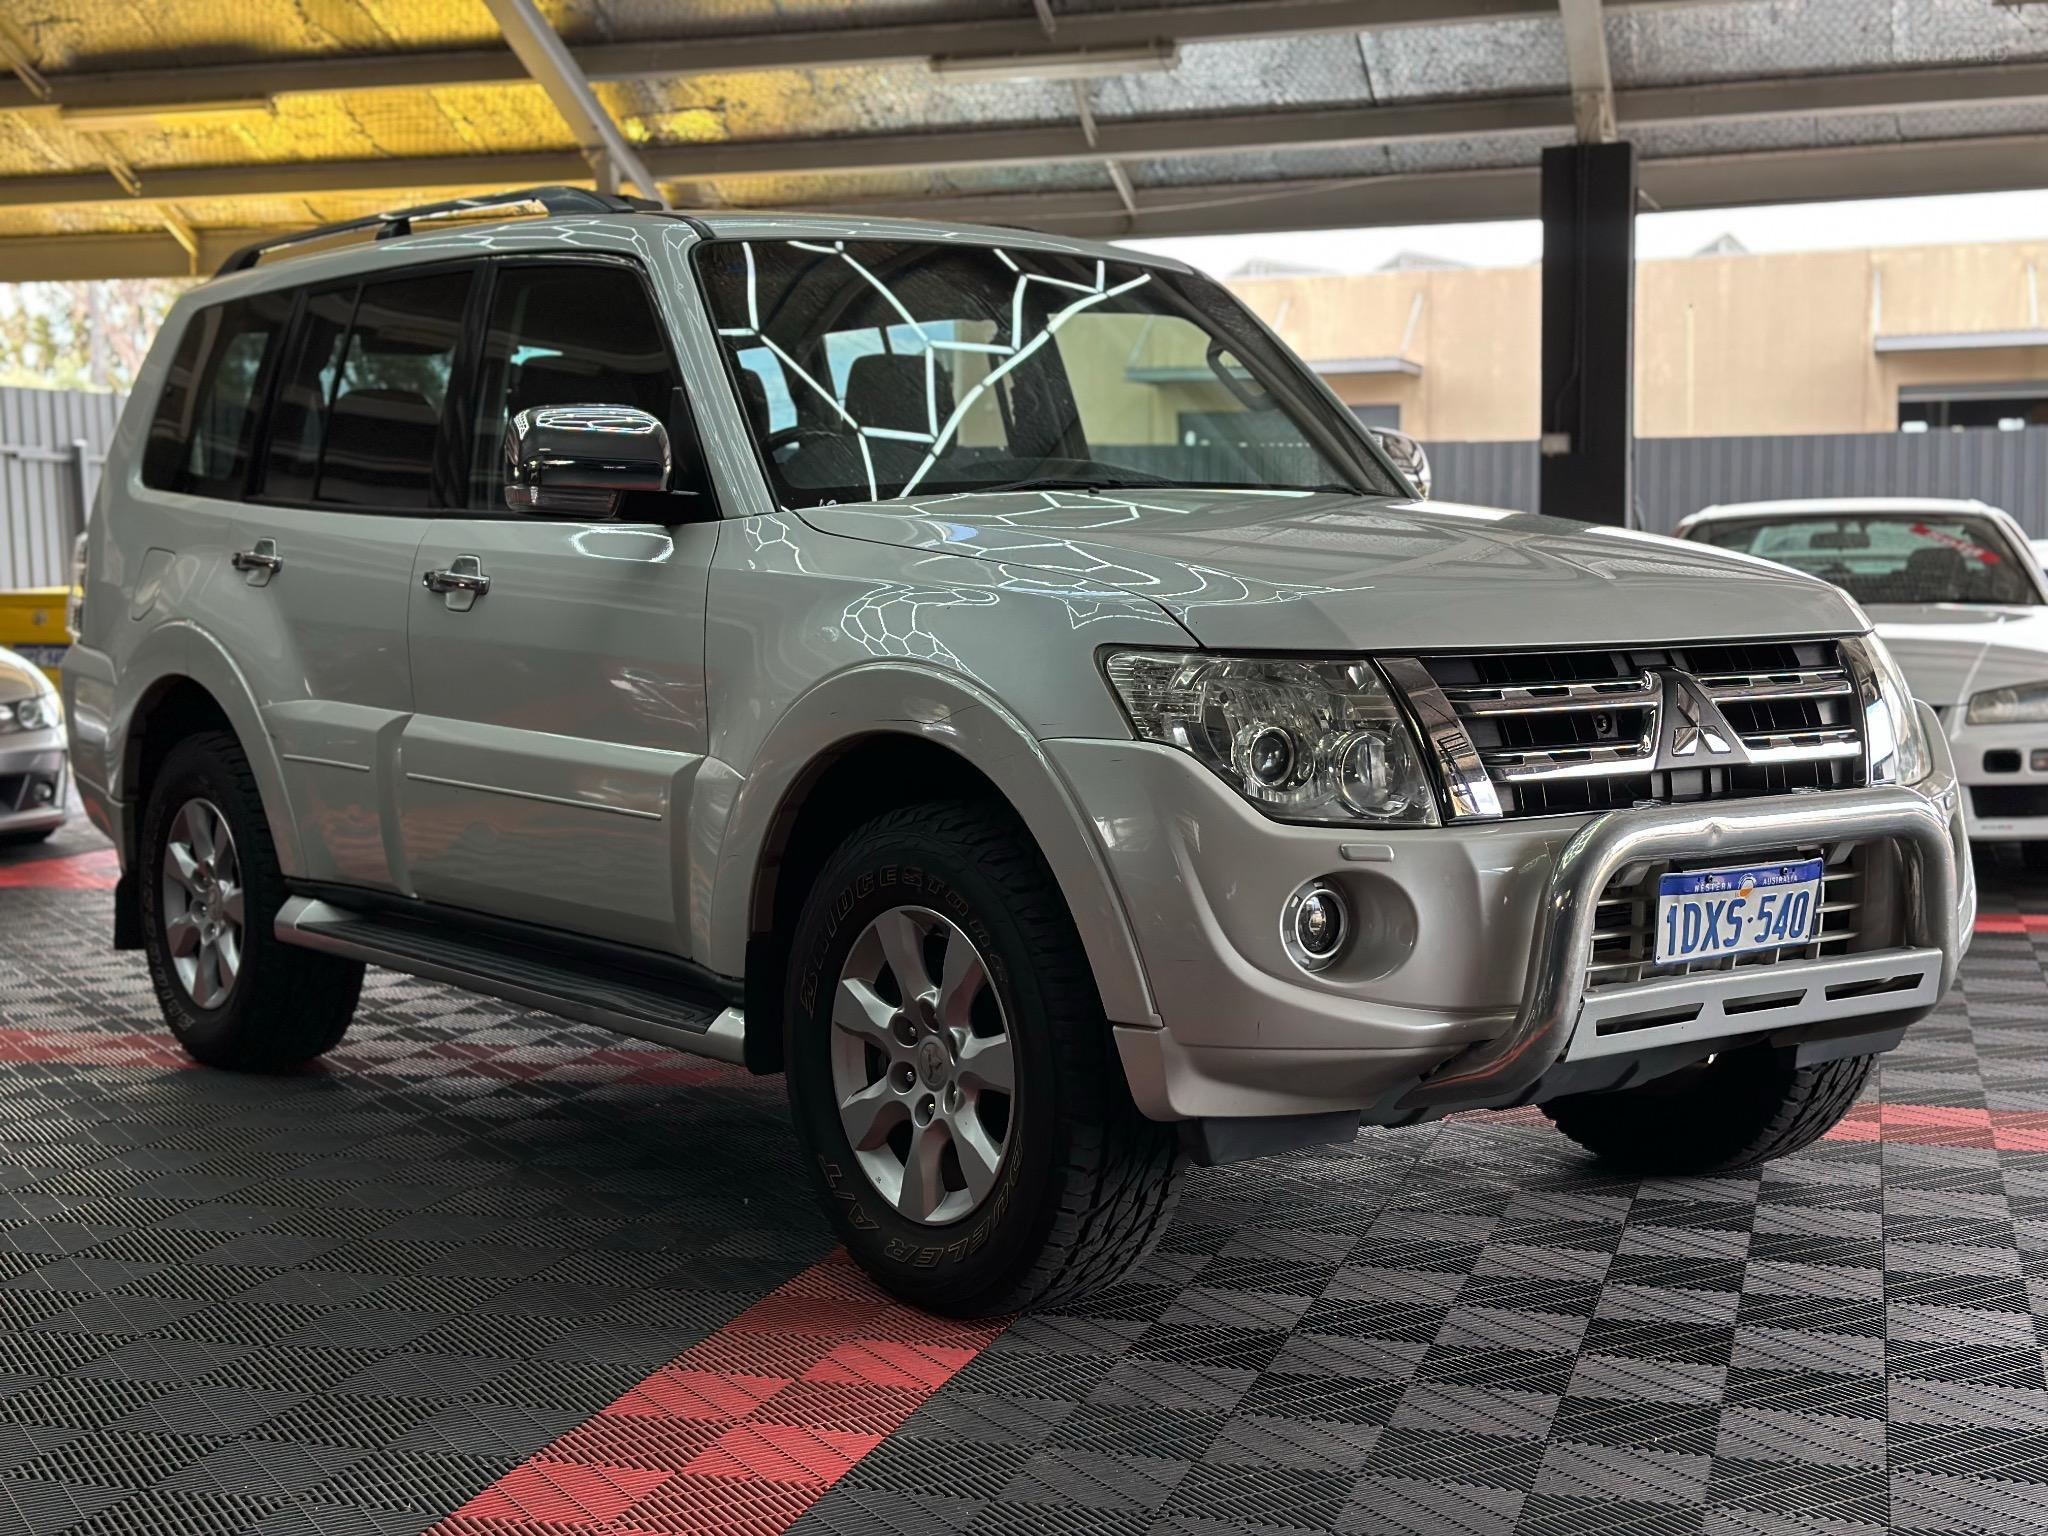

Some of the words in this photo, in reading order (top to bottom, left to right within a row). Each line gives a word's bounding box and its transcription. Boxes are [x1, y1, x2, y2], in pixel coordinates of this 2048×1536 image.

[1694, 882, 1732, 893] WESTERN
[1763, 875, 1798, 886] AUSTRALIA
[884, 1130, 1023, 1268] DUELER
